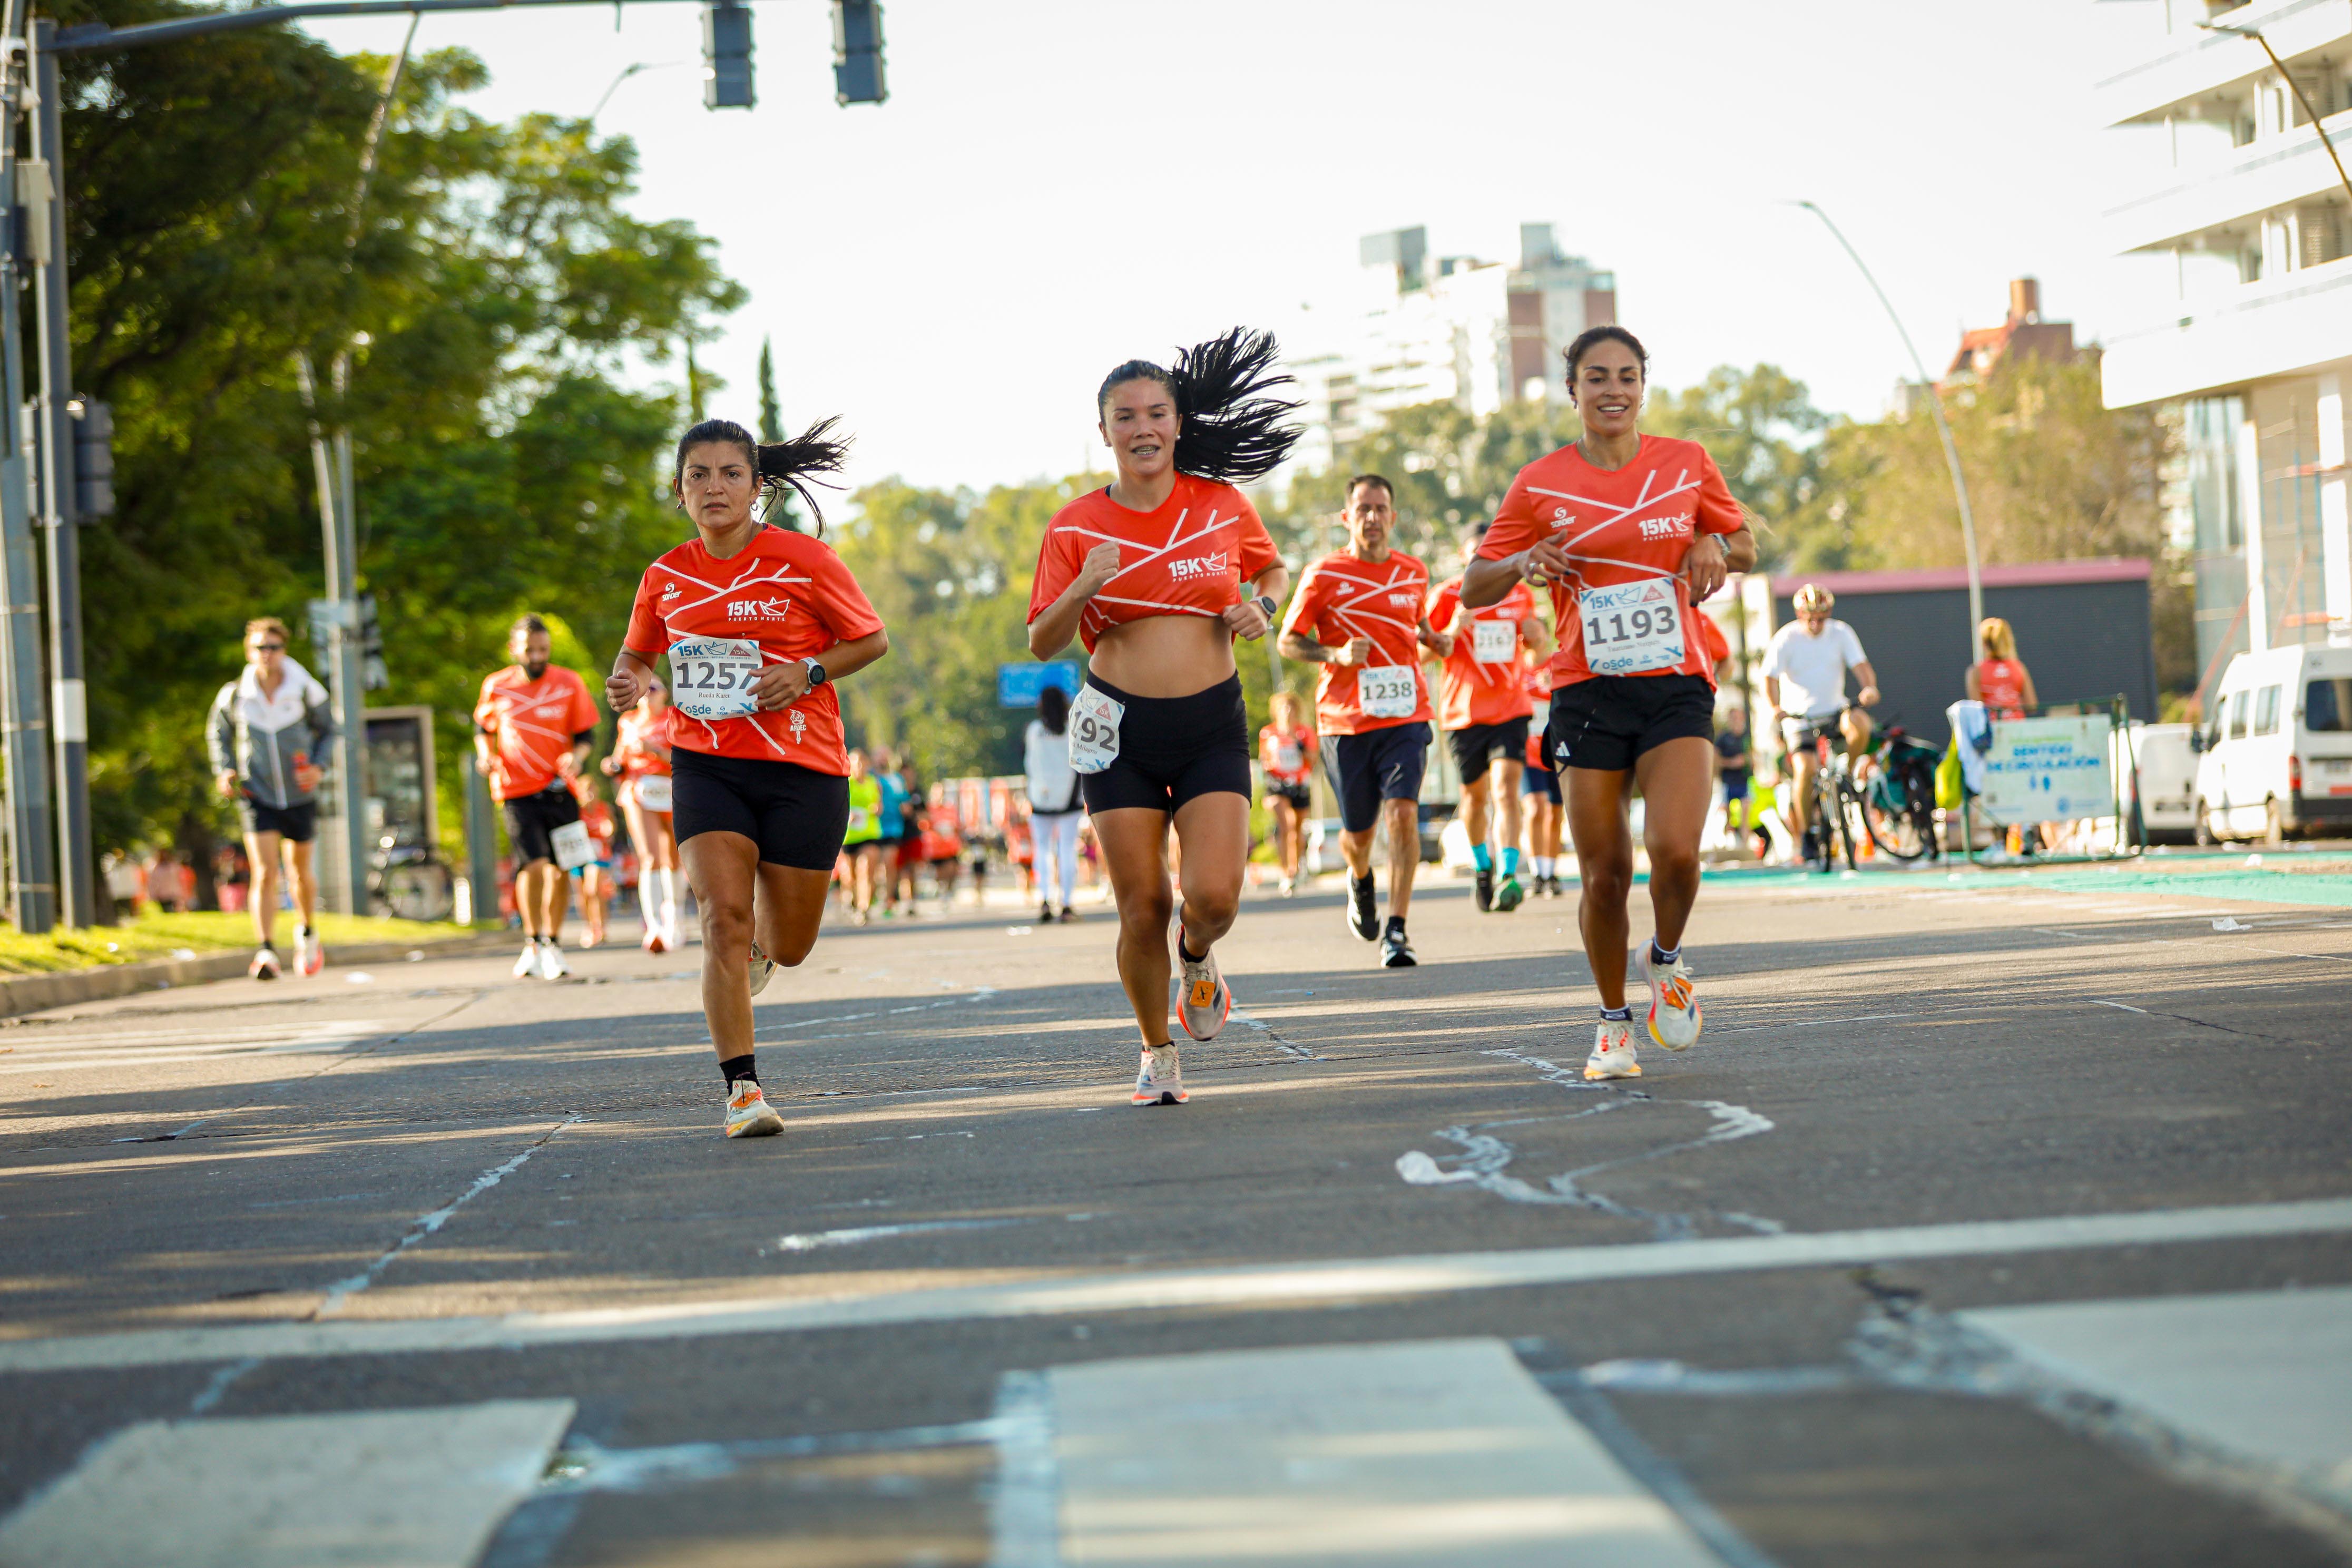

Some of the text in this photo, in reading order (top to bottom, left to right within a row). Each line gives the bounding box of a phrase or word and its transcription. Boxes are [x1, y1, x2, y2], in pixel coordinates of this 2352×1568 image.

[1639, 517, 1673, 536] 15K
[1168, 558, 1203, 577] 15K
[1173, 573, 1204, 582] PUERTO
[727, 601, 758, 616] 15K
[1590, 594, 1614, 609] 15K
[1587, 606, 1675, 645] 1193
[678, 645, 704, 656] 15K
[1602, 656, 1633, 670] osde
[676, 662, 758, 690] 1257
[1364, 682, 1412, 701] 1238
[685, 704, 711, 716] osde
[1099, 707, 1109, 717] 15K
[1076, 743, 1097, 754] Milagros
